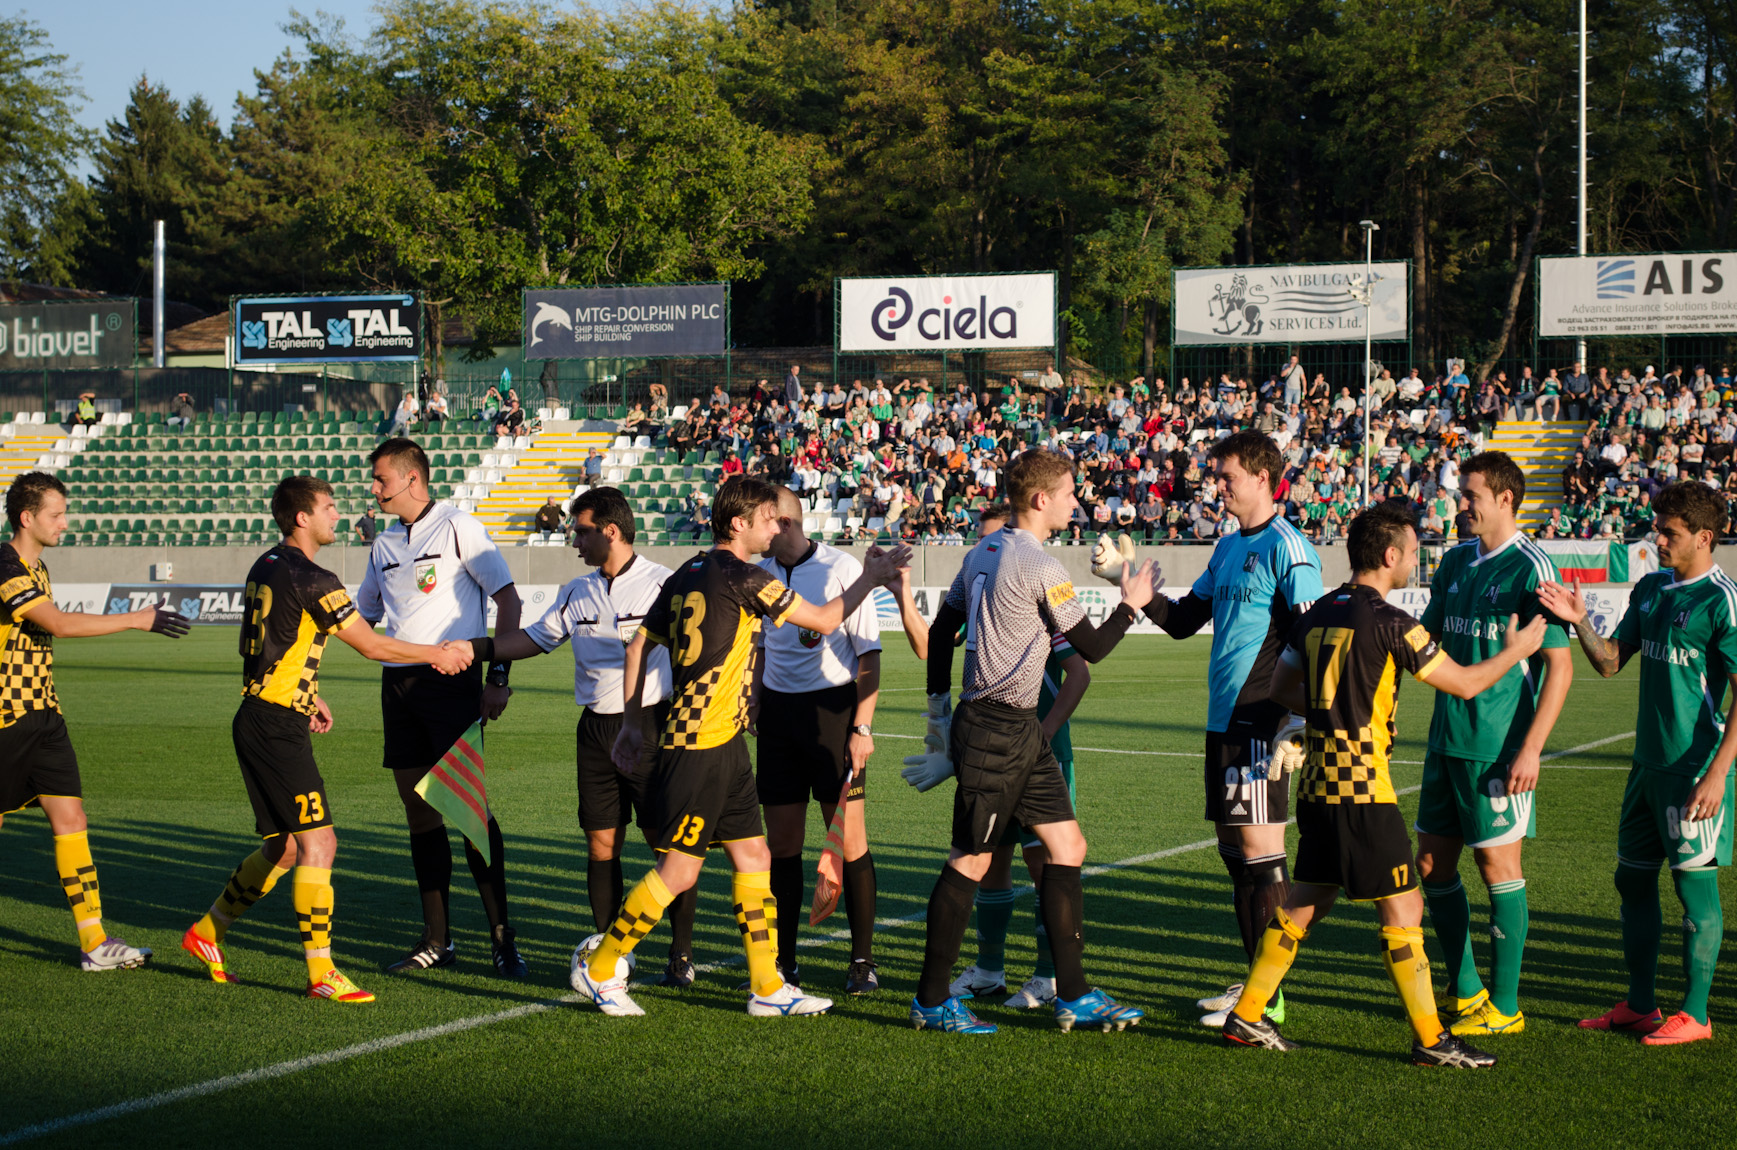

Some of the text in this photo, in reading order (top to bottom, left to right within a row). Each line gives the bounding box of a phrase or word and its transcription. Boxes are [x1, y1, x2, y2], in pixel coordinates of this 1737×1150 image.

[1643, 258, 1724, 295] AIS
[575, 304, 720, 323] MTG-DOLPHIN PLC
[917, 295, 1017, 340] ciela
[1572, 304, 1612, 313] Advance
[1615, 303, 1660, 313] Insurance
[1664, 301, 1708, 312] Solutions
[262, 311, 324, 338] TAL
[348, 308, 413, 336] TAL
[574, 323, 674, 334] SHIP REPAIR CONVERSION
[1269, 316, 1362, 331] SERVICES Ltd.
[14, 313, 104, 357] biovet
[268, 337, 325, 351] Engineering
[354, 334, 414, 350] Engineering
[574, 332, 632, 342] SHIP BUILDING
[128, 591, 178, 613] TAL
[199, 591, 246, 613] TAL
[1305, 626, 1356, 711] 17
[1225, 766, 1252, 801] 91
[295, 791, 325, 825] 23
[1391, 863, 1408, 889] 17
